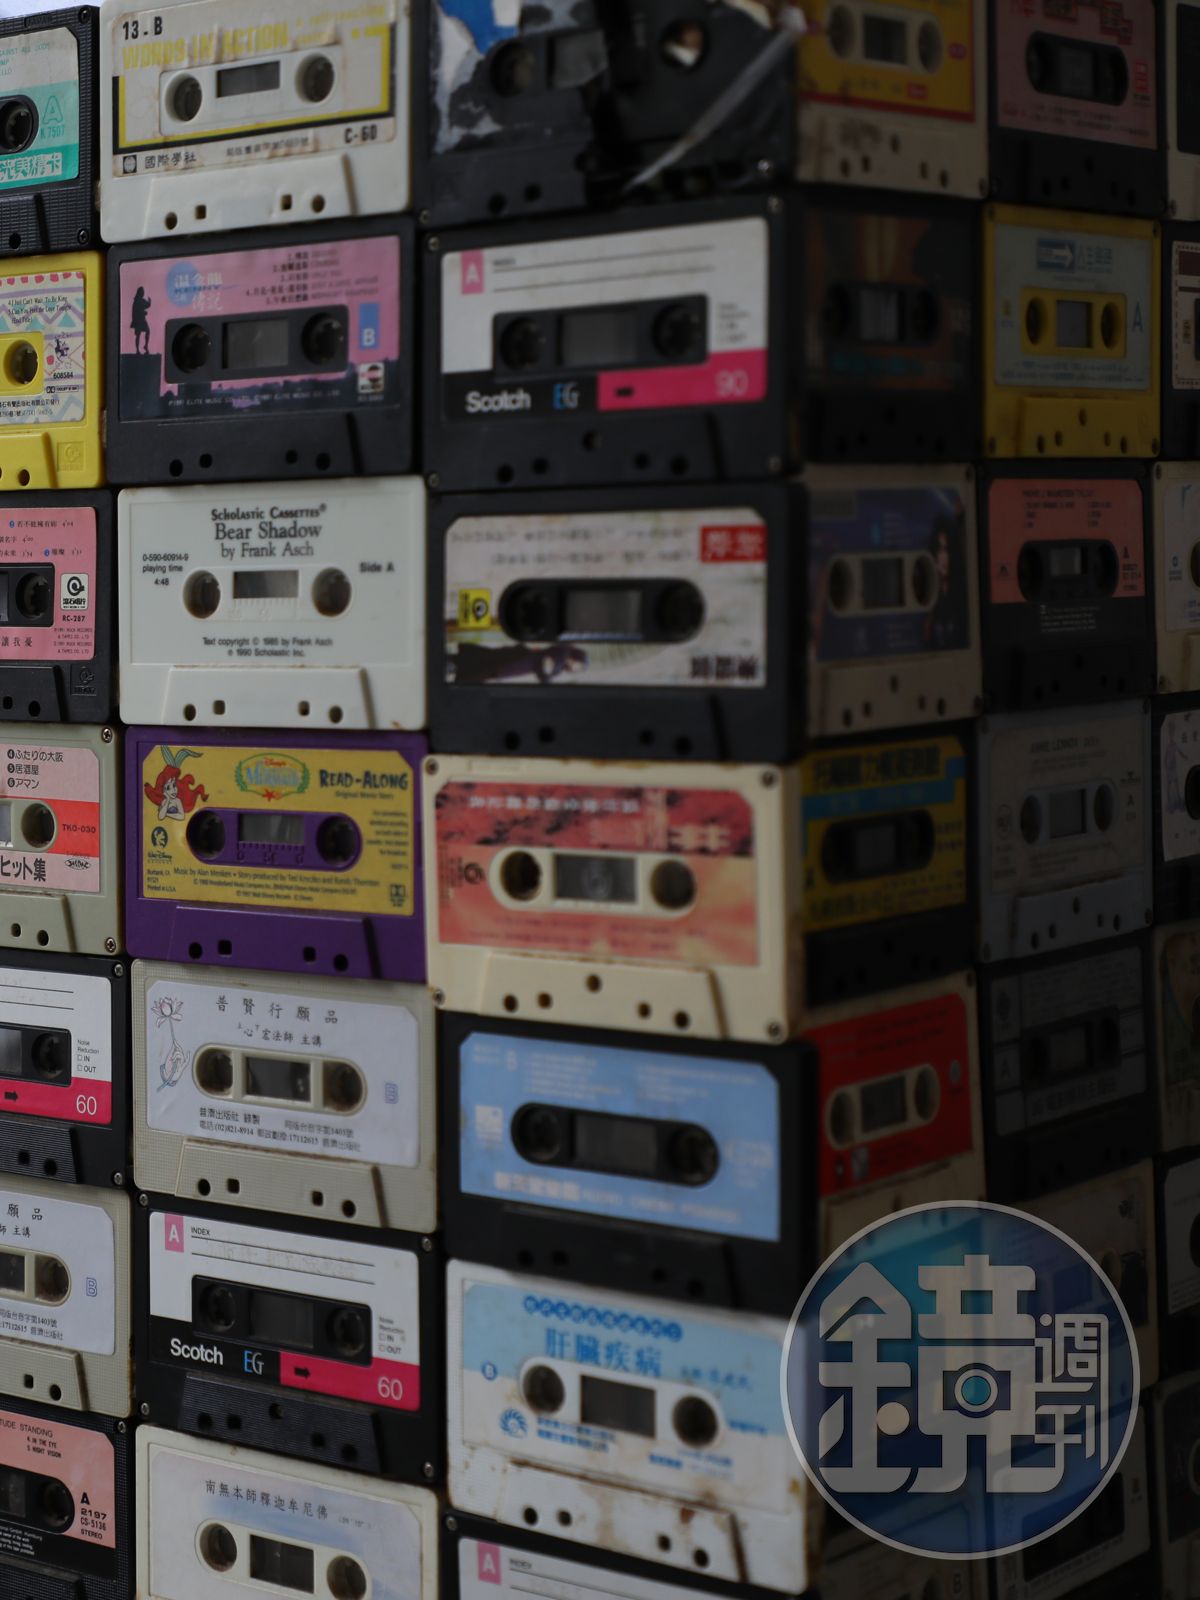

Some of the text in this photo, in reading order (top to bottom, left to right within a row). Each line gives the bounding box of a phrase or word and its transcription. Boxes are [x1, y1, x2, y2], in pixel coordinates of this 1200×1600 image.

[122, 22, 288, 69] WORDS IN ACTION
[42, 95, 64, 125] A
[145, 124, 377, 169] 國際學社 C-60
[464, 263, 481, 284] A
[362, 328, 374, 346] B
[465, 369, 749, 414] Scotch EG 90
[214, 520, 322, 540] Bear Shadow
[220, 540, 314, 561] by Frank Asch
[142, 563, 183, 574] playing time
[359, 562, 395, 573] Side A
[62, 614, 86, 622] RC-287
[203, 636, 333, 648] Text copyright by Frank Asch
[254, 648, 290, 657] Scholastic
[15, 778, 39, 789] アマン
[319, 768, 408, 790] READ-ALONG
[216, 995, 338, 1025] 普賢行願品
[77, 1038, 91, 1046] Noise
[301, 1031, 322, 1047] 主講
[77, 1046, 100, 1055] Reduction
[83, 1065, 96, 1073] OUT
[76, 1094, 97, 1116] 60
[13, 1224, 31, 1238] 主講
[168, 1223, 180, 1243] A
[191, 1226, 211, 1236] INDEX
[86, 1276, 98, 1298] B
[386, 1344, 401, 1354] OUT
[545, 1327, 662, 1378] 肝臟疾病
[170, 1338, 403, 1401] Scotch EG 60
[19, 1423, 53, 1438] STANDING
[80, 1492, 90, 1505] A
[205, 1479, 328, 1521] 南無本師釋迦牟尼佛
[81, 1507, 107, 1520] 2197
[80, 1528, 103, 1540] STEREO
[481, 1553, 496, 1574] A
